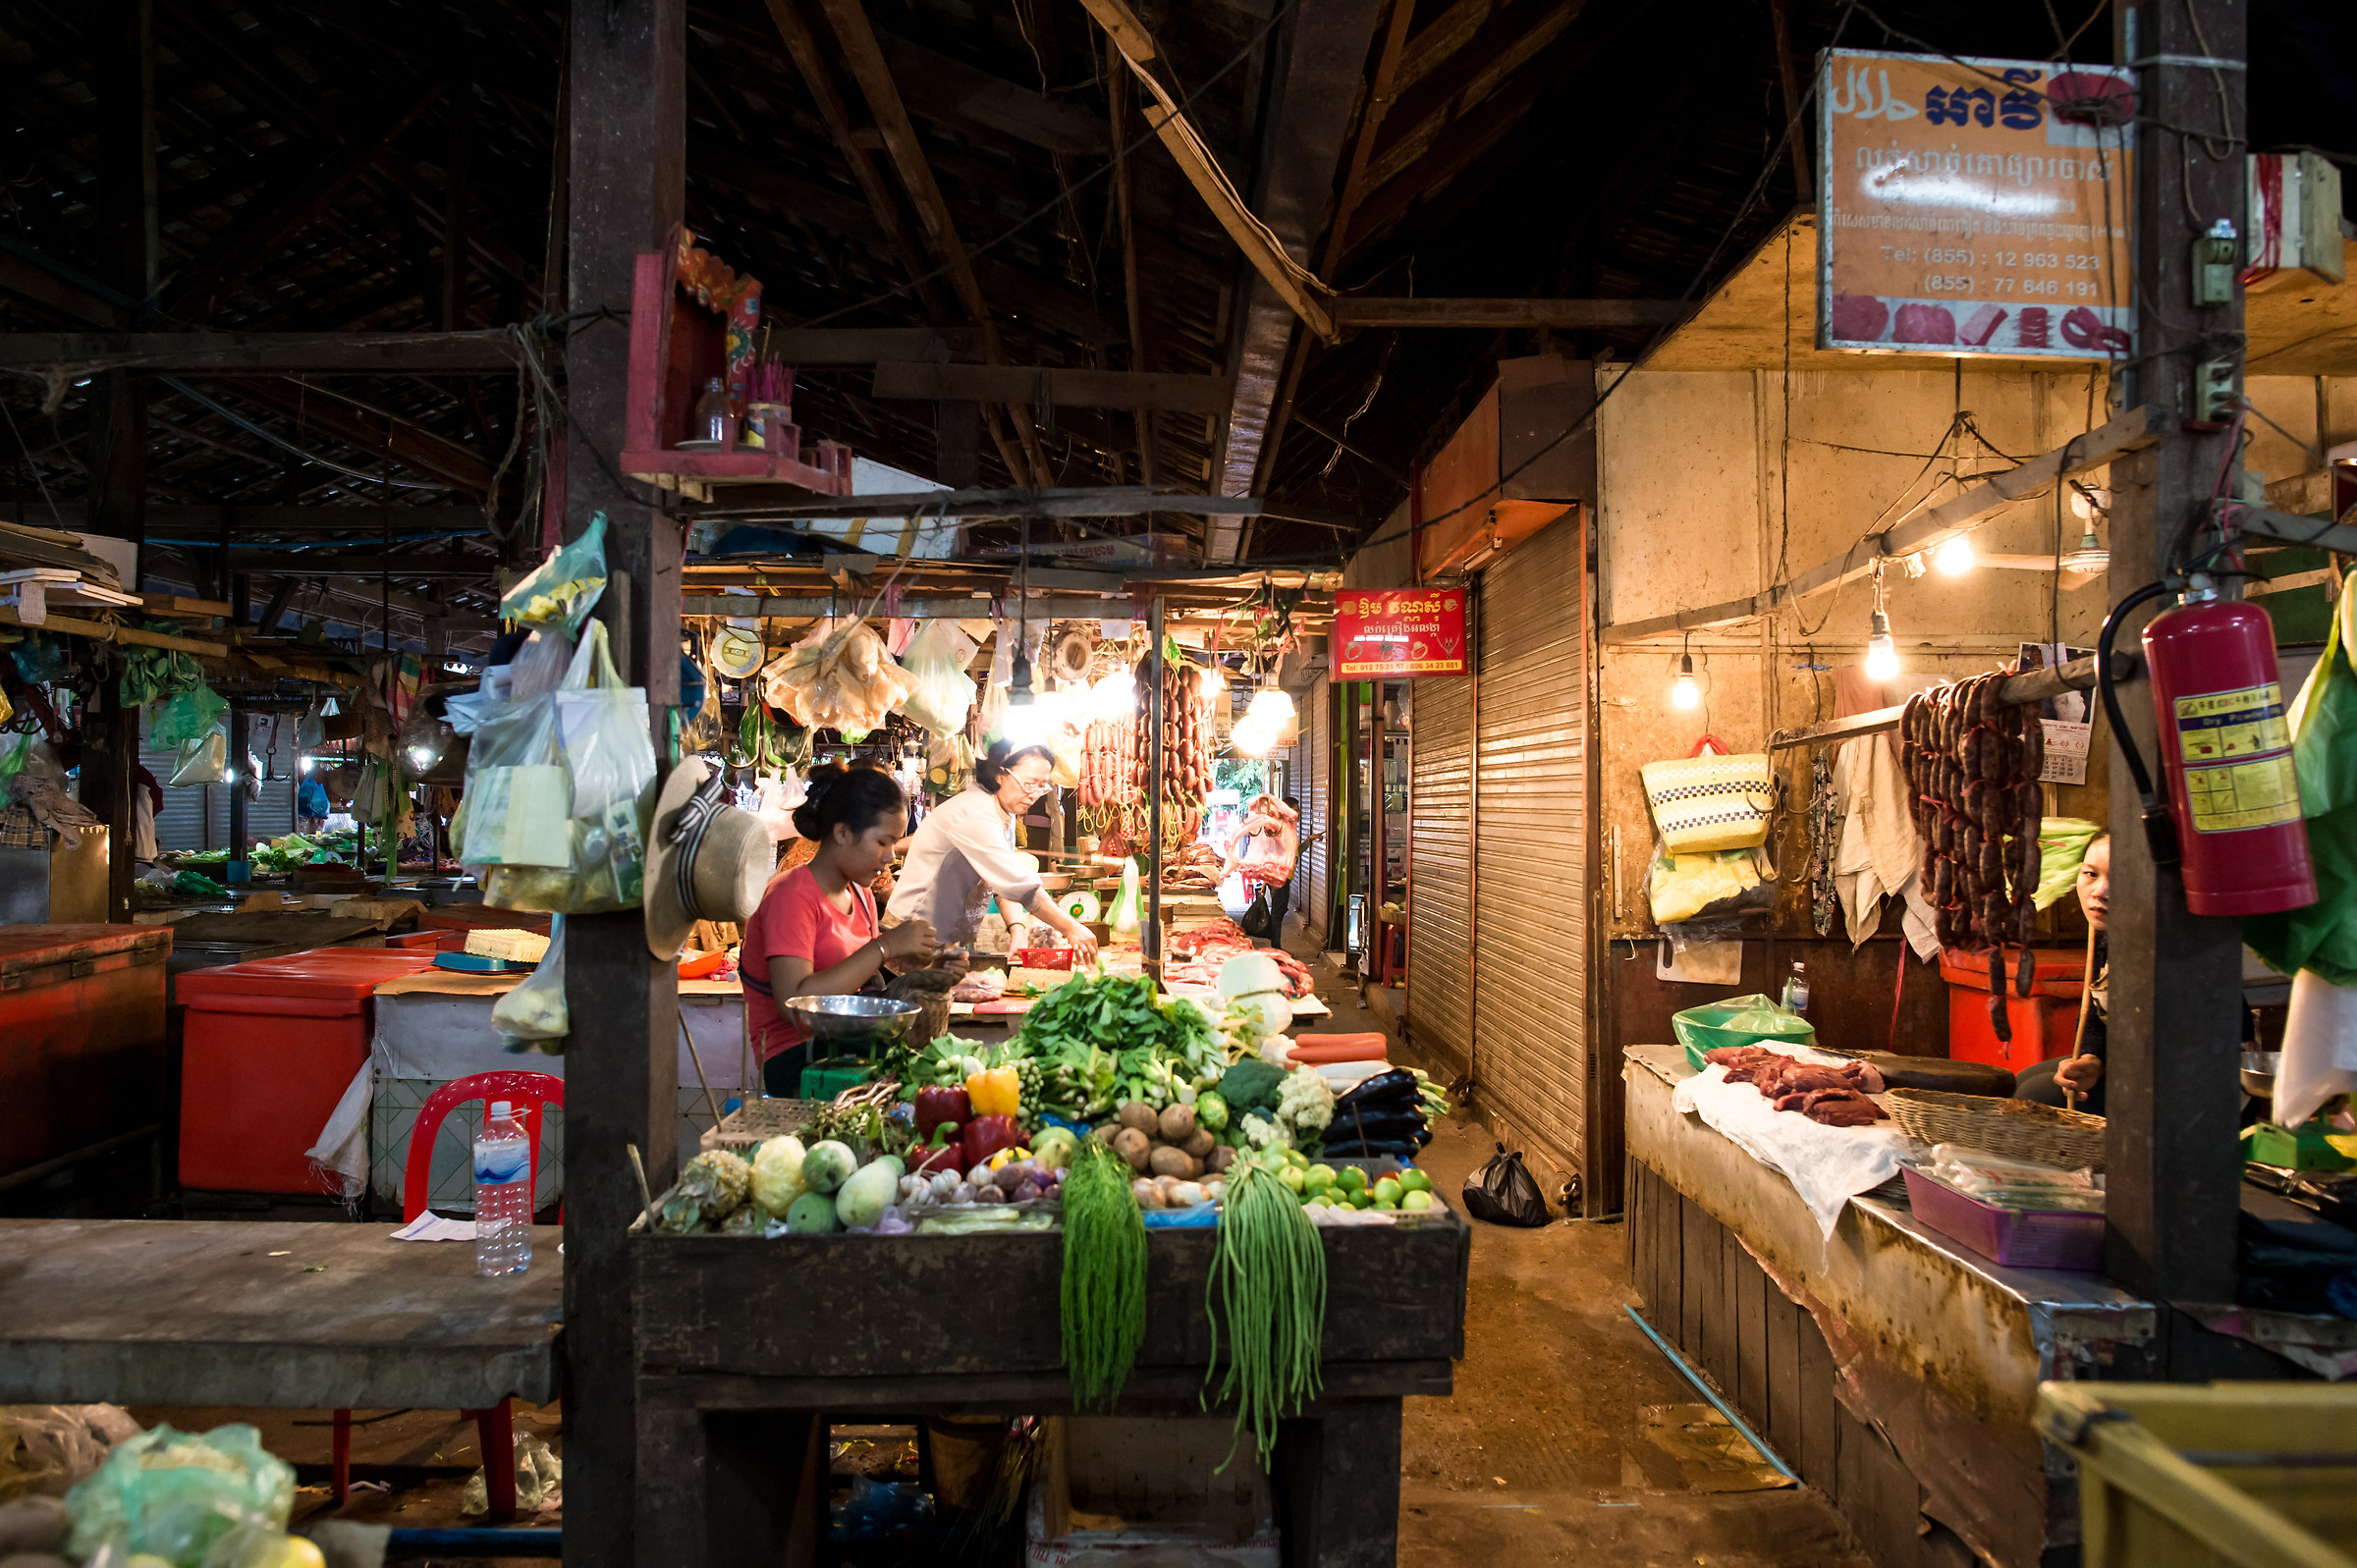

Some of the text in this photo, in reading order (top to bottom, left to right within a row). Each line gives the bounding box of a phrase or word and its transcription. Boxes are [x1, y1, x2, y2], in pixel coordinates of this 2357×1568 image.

[1880, 245, 1917, 263] Tel:
[1924, 247, 1975, 267] (855)
[1995, 251, 2017, 267] 12
[2022, 253, 2058, 269] 963
[2064, 254, 2101, 270] 523
[1924, 274, 1975, 294] (855)
[1994, 278, 2015, 293] 77
[2022, 279, 2058, 295] 646
[2065, 281, 2098, 297] 191
